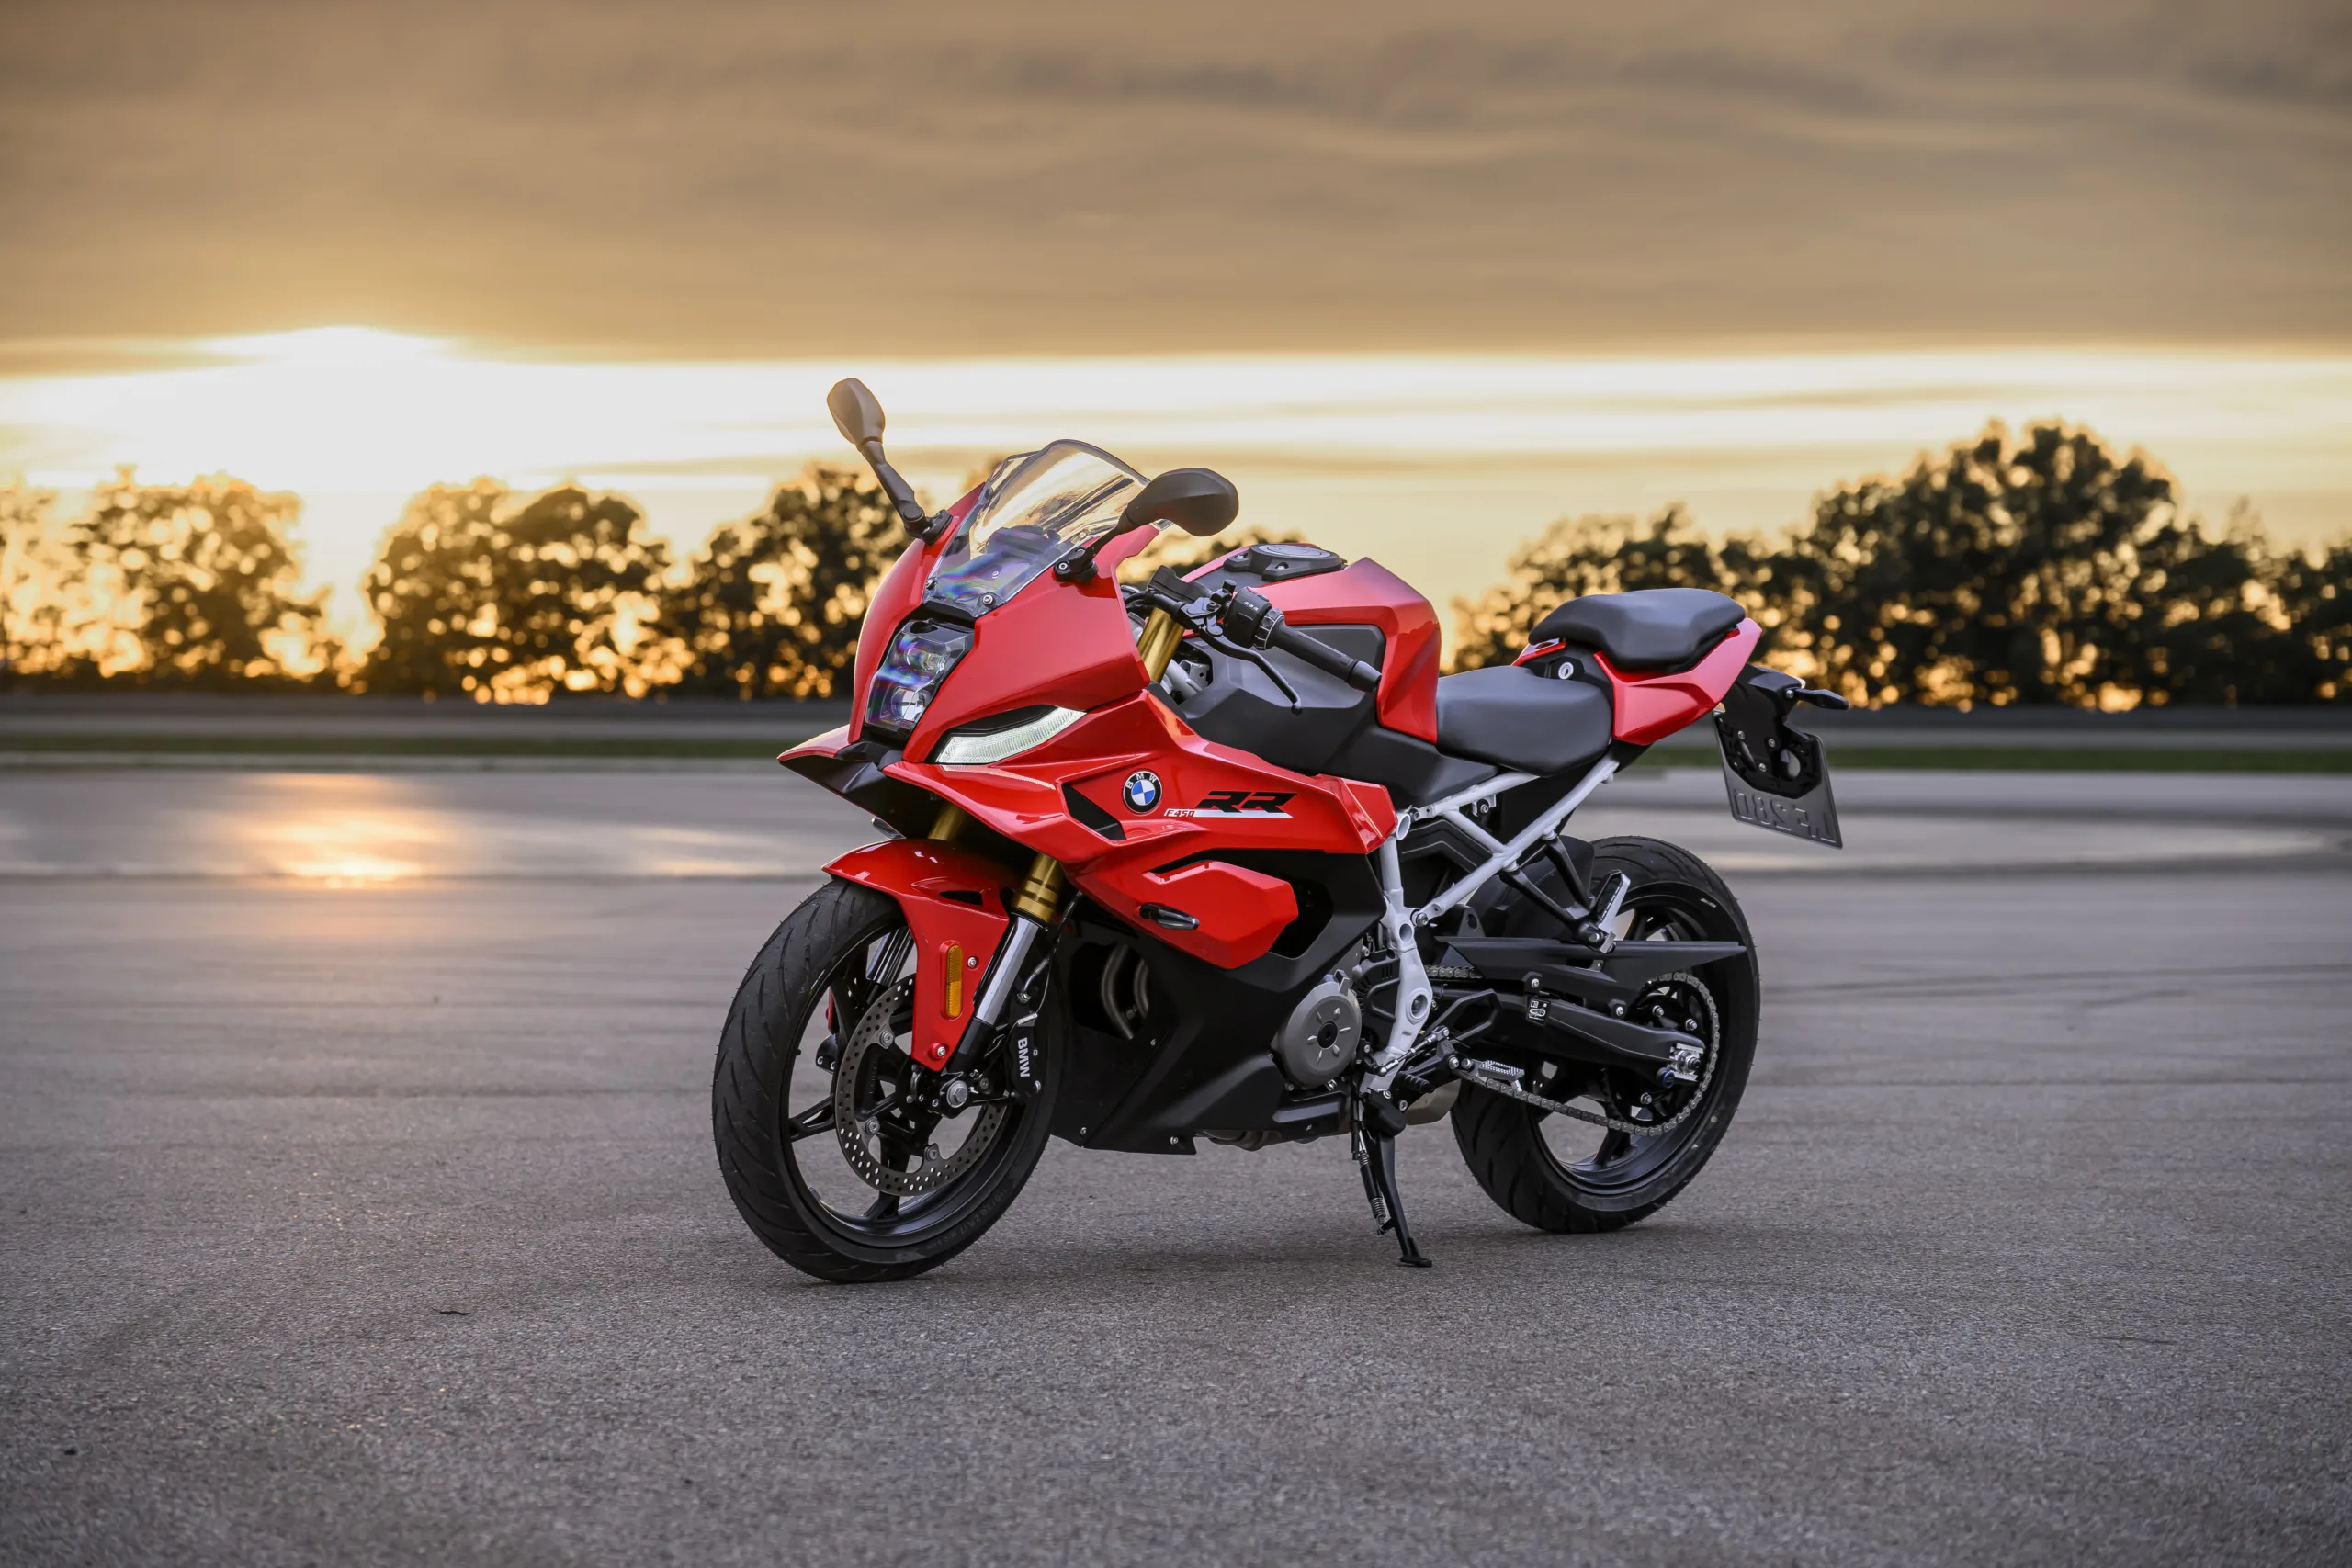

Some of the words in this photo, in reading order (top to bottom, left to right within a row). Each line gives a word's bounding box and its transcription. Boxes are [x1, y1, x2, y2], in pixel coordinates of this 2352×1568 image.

[1125, 772, 1158, 789] BMW
[1195, 791, 1297, 813] RR
[1017, 1037, 1030, 1077] BMW
